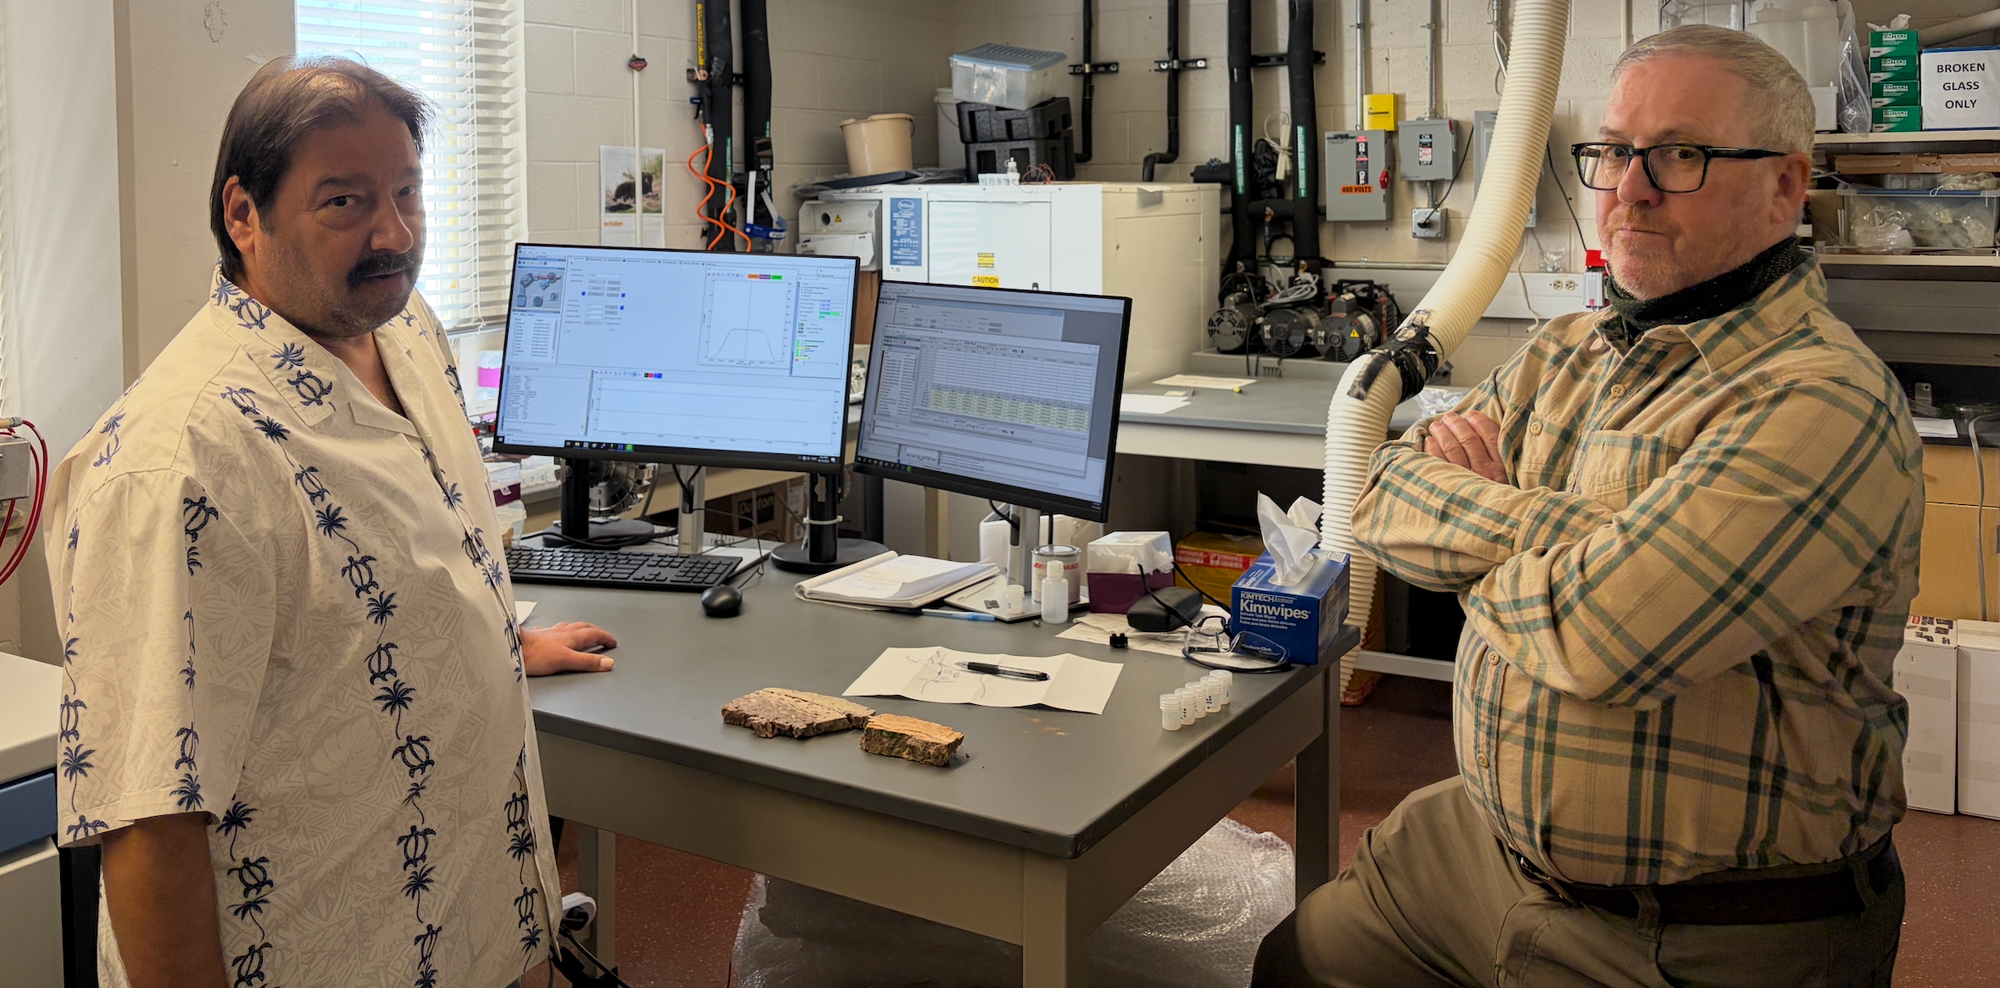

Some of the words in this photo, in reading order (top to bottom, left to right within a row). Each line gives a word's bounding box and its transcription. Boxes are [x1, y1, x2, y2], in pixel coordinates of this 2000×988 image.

[1937, 62, 1986, 73] BROKEN
[1942, 81, 1980, 91] GLASS
[1945, 99, 1978, 109] ONLY
[972, 276, 999, 284] CAUTION
[740, 495, 774, 514] Daton
[1241, 591, 1274, 602] KIMTECH
[1240, 598, 1309, 620] Kimwipes
